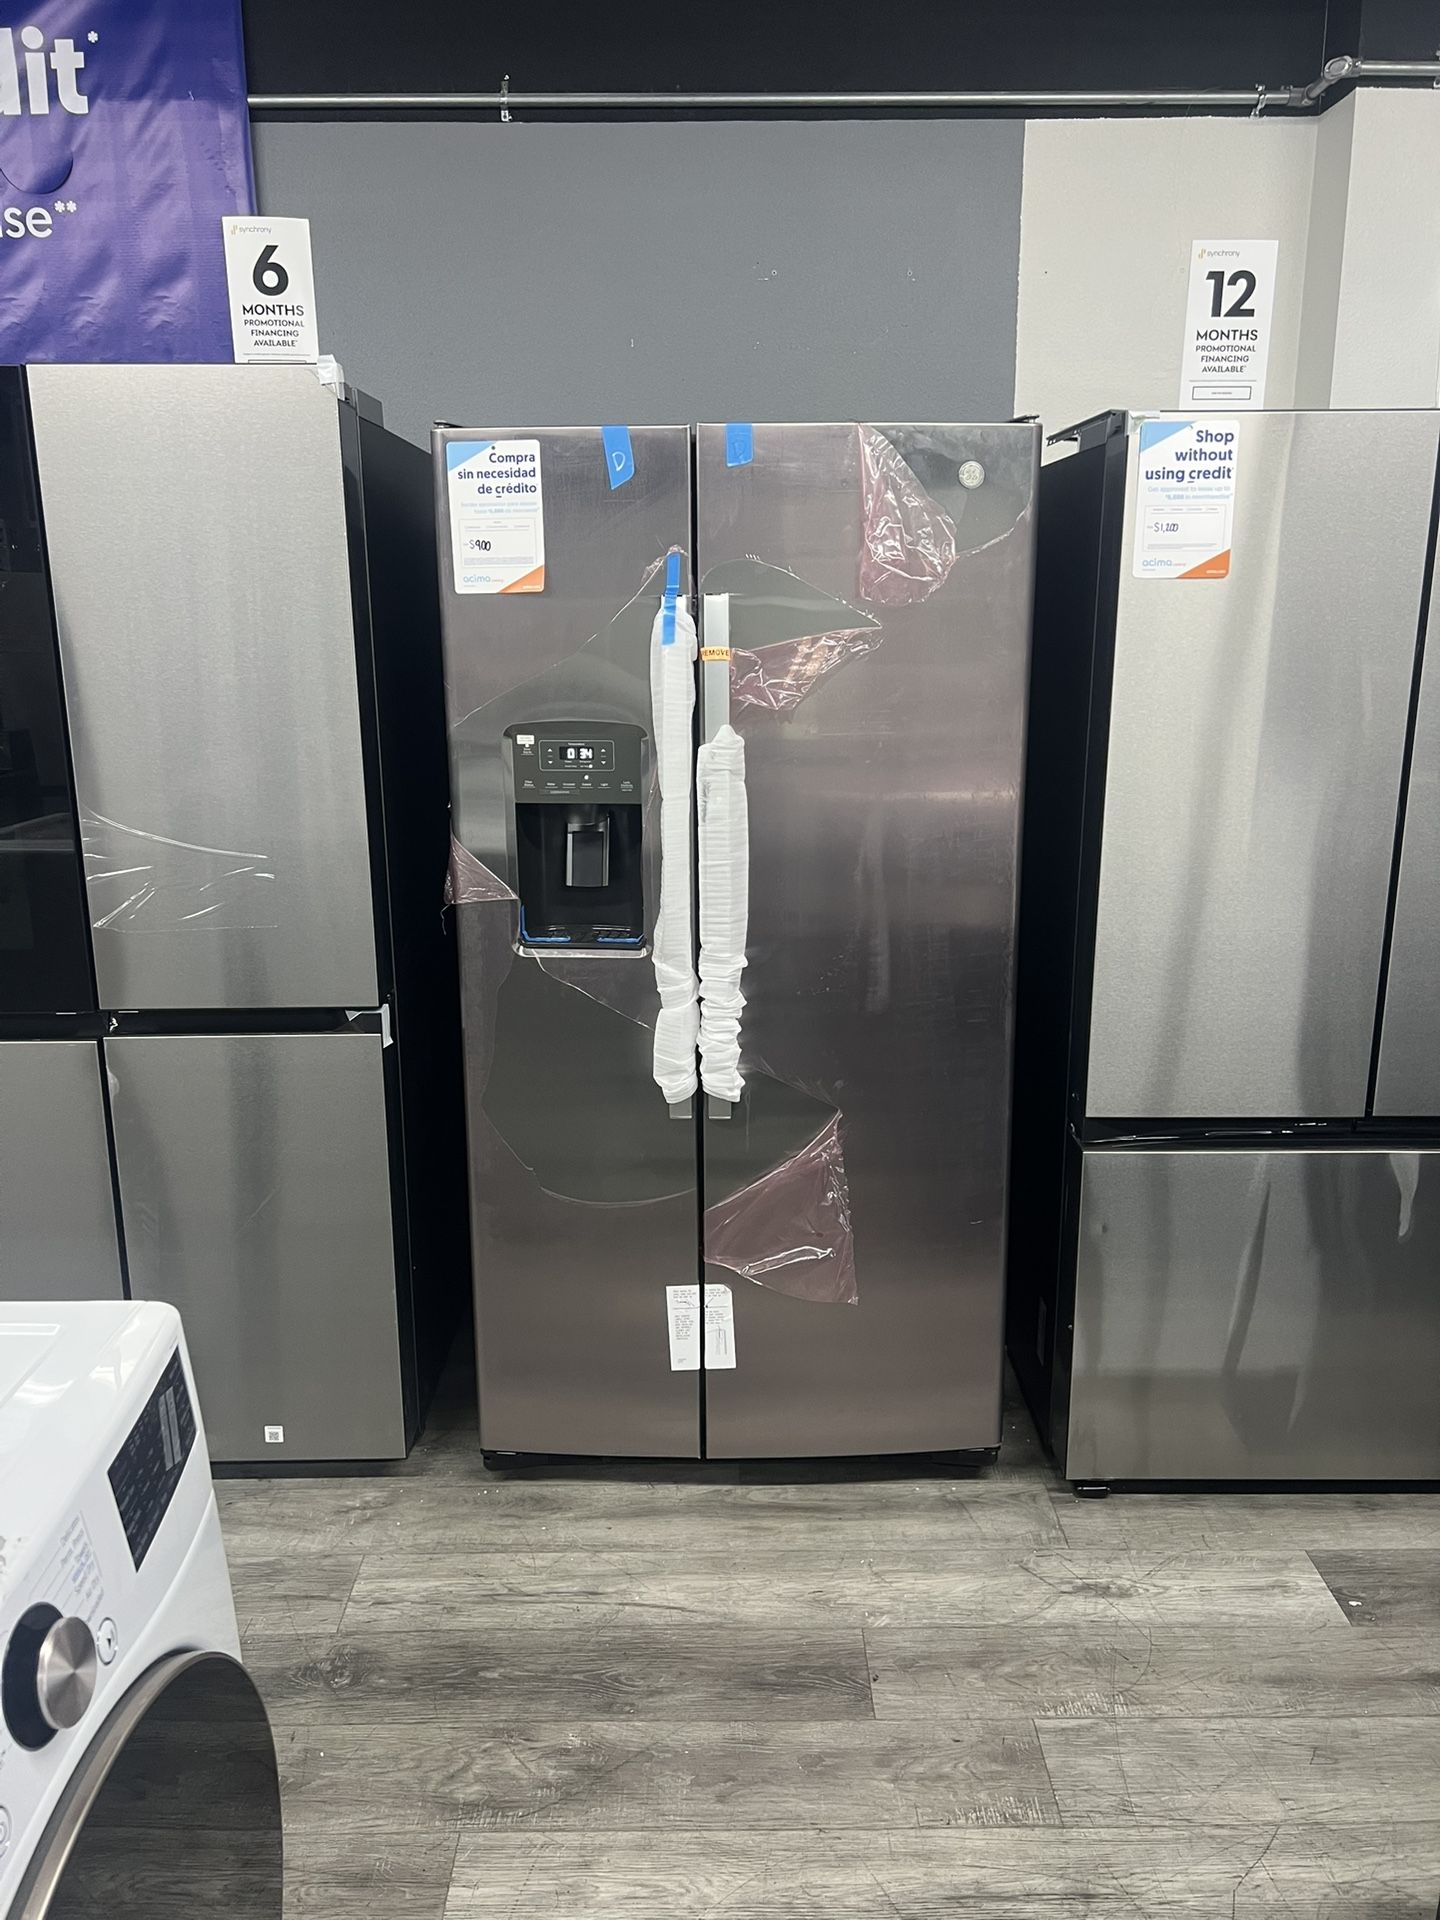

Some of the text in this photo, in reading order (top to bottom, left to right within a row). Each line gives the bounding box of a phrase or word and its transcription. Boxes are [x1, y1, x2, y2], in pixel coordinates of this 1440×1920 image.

[239, 225, 272, 234] synchrony
[1207, 249, 1240, 258] synchrony
[253, 245, 289, 296] 6
[1206, 270, 1256, 318] 12
[242, 304, 304, 316] MONTHS
[244, 319, 304, 328] PROMOTIONAL
[251, 329, 299, 337] FINANCING
[1196, 329, 1258, 341] MONTHS
[1195, 345, 1256, 353] PROMOTIONAL
[1201, 355, 1250, 363] FINANCING
[1196, 430, 1234, 445] Shop
[489, 453, 536, 465] Compra
[1175, 449, 1233, 462] without
[612, 451, 626, 472] D
[458, 467, 536, 480] sin necesidad
[1145, 467, 1185, 482] using
[478, 484, 493, 494] de
[1142, 558, 1172, 567] acima
[463, 574, 491, 583] acima
[580, 748, 593, 759] 34
